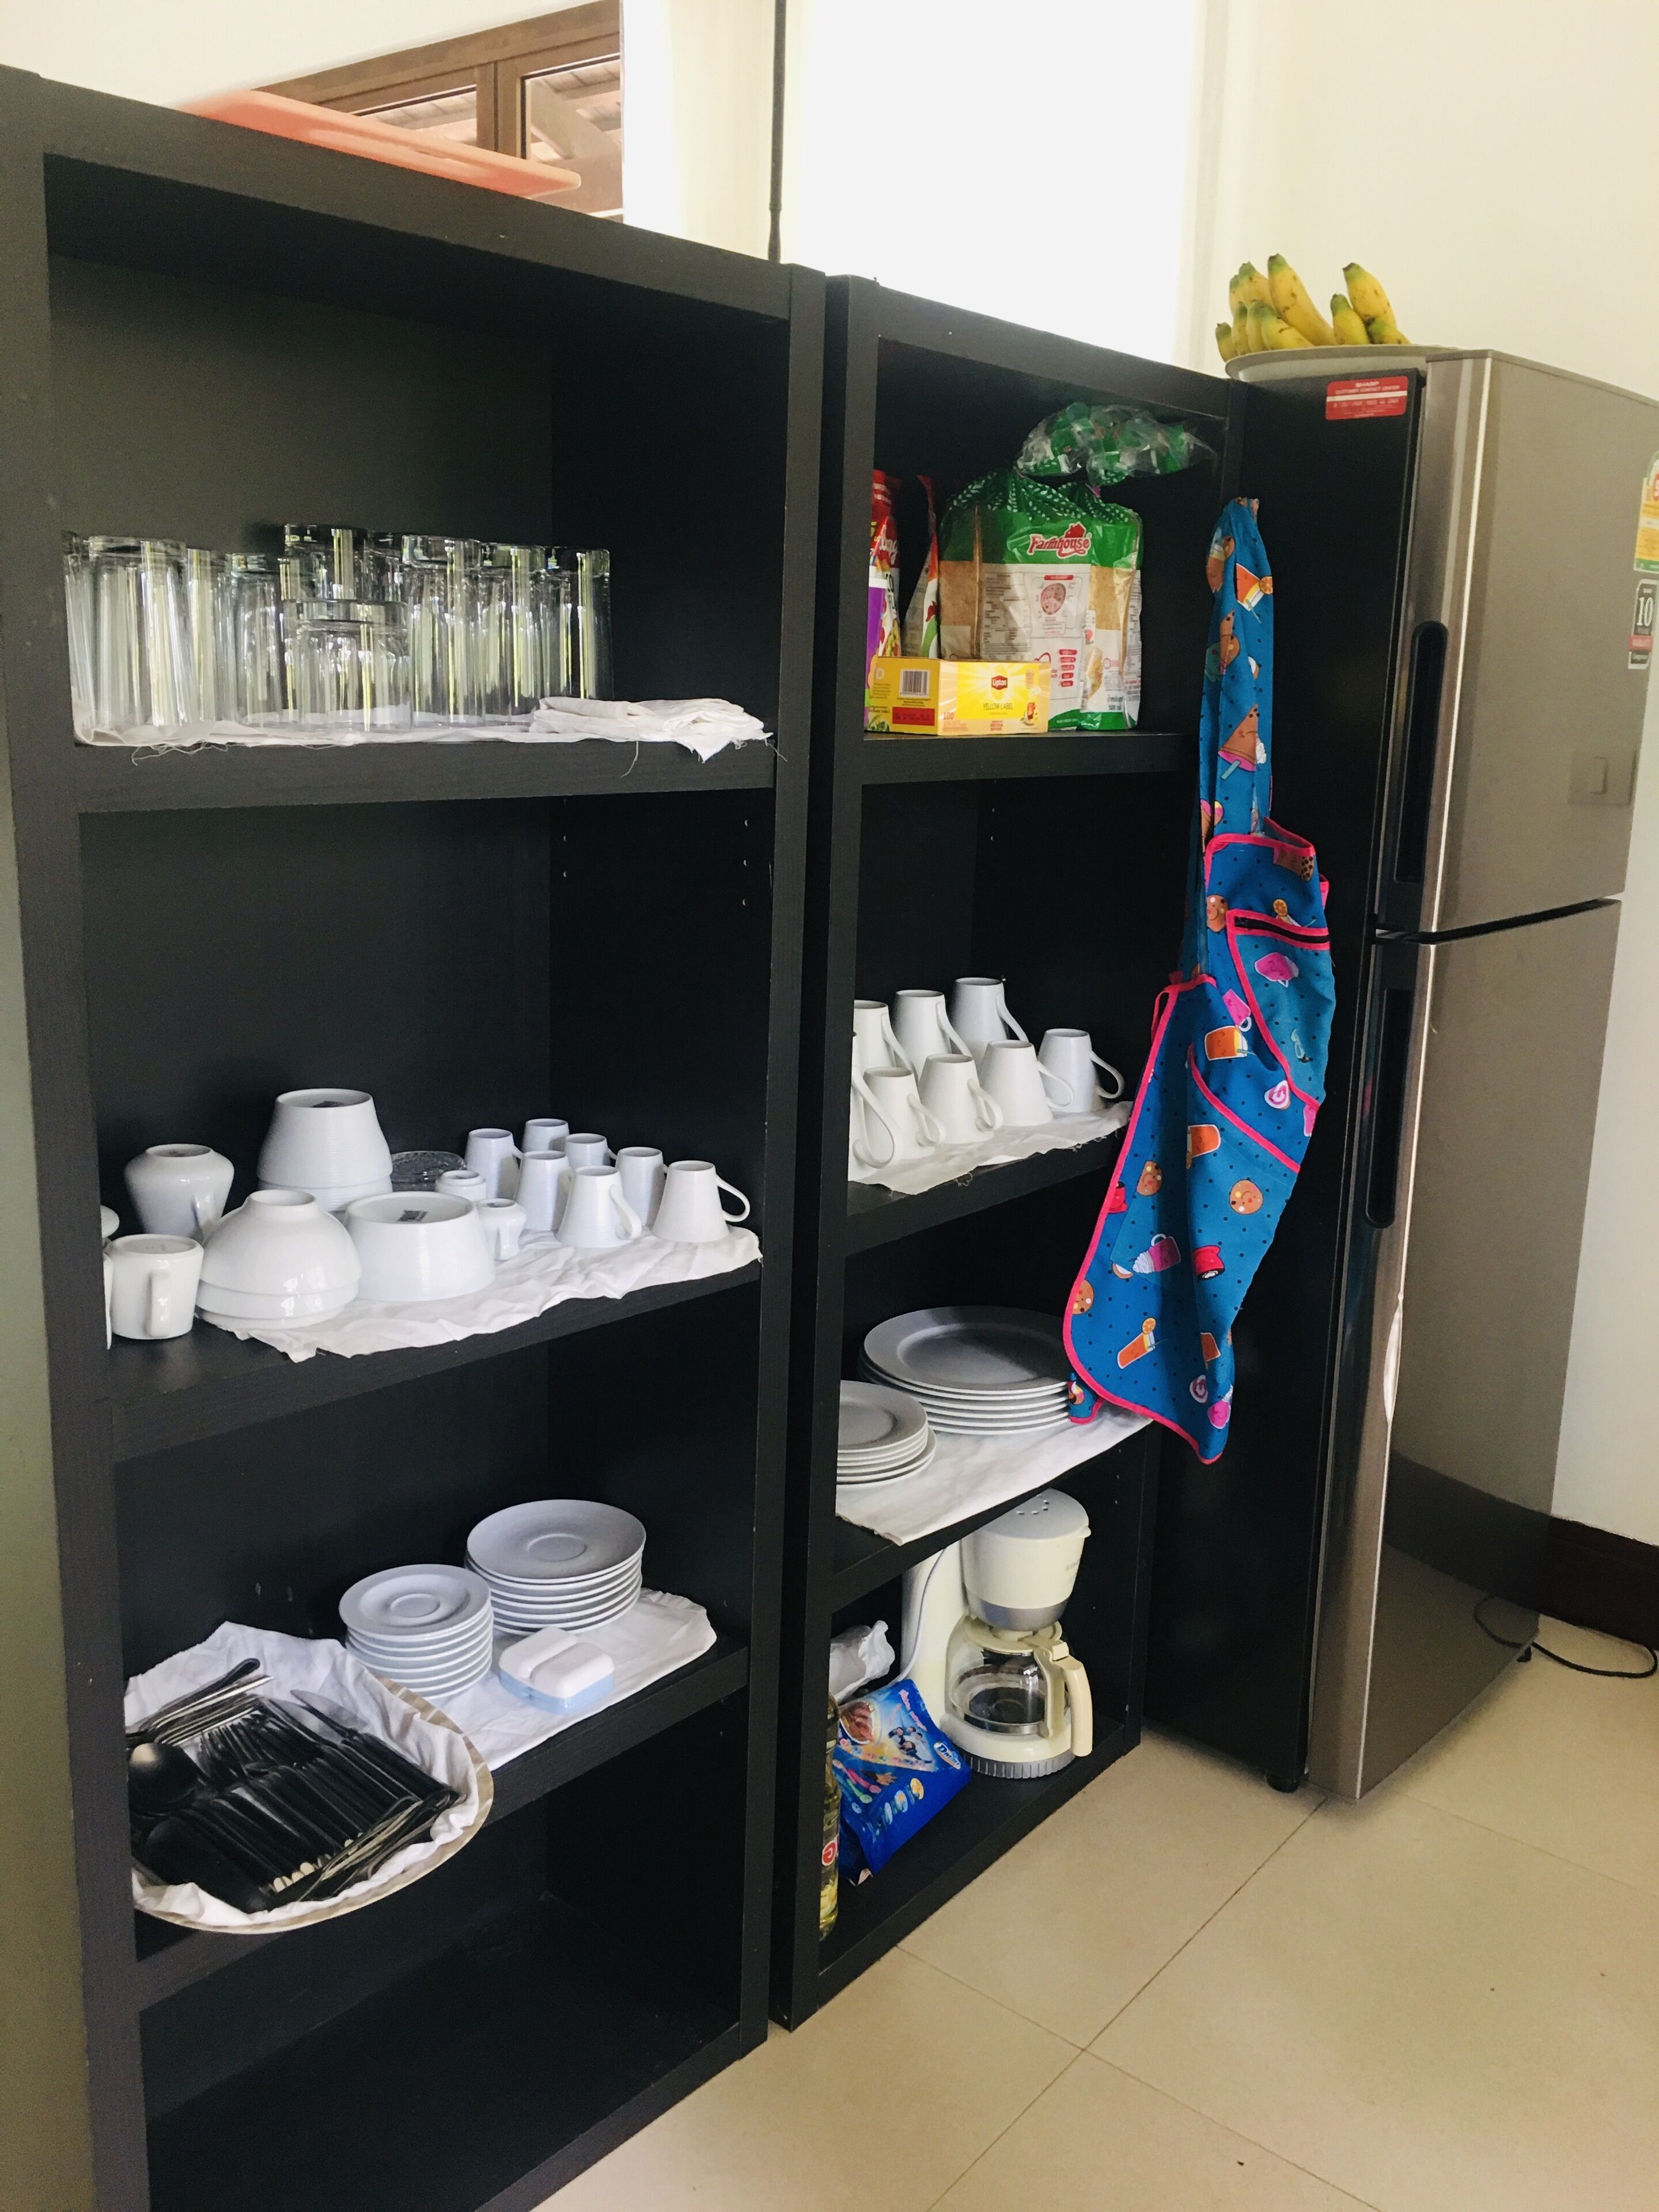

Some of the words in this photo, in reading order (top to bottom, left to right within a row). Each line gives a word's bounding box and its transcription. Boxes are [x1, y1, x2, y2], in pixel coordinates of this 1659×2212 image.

[1028, 535, 1090, 557] Farmhouse
[1637, 597, 1653, 626] 10
[993, 679, 1007, 687] Lipton
